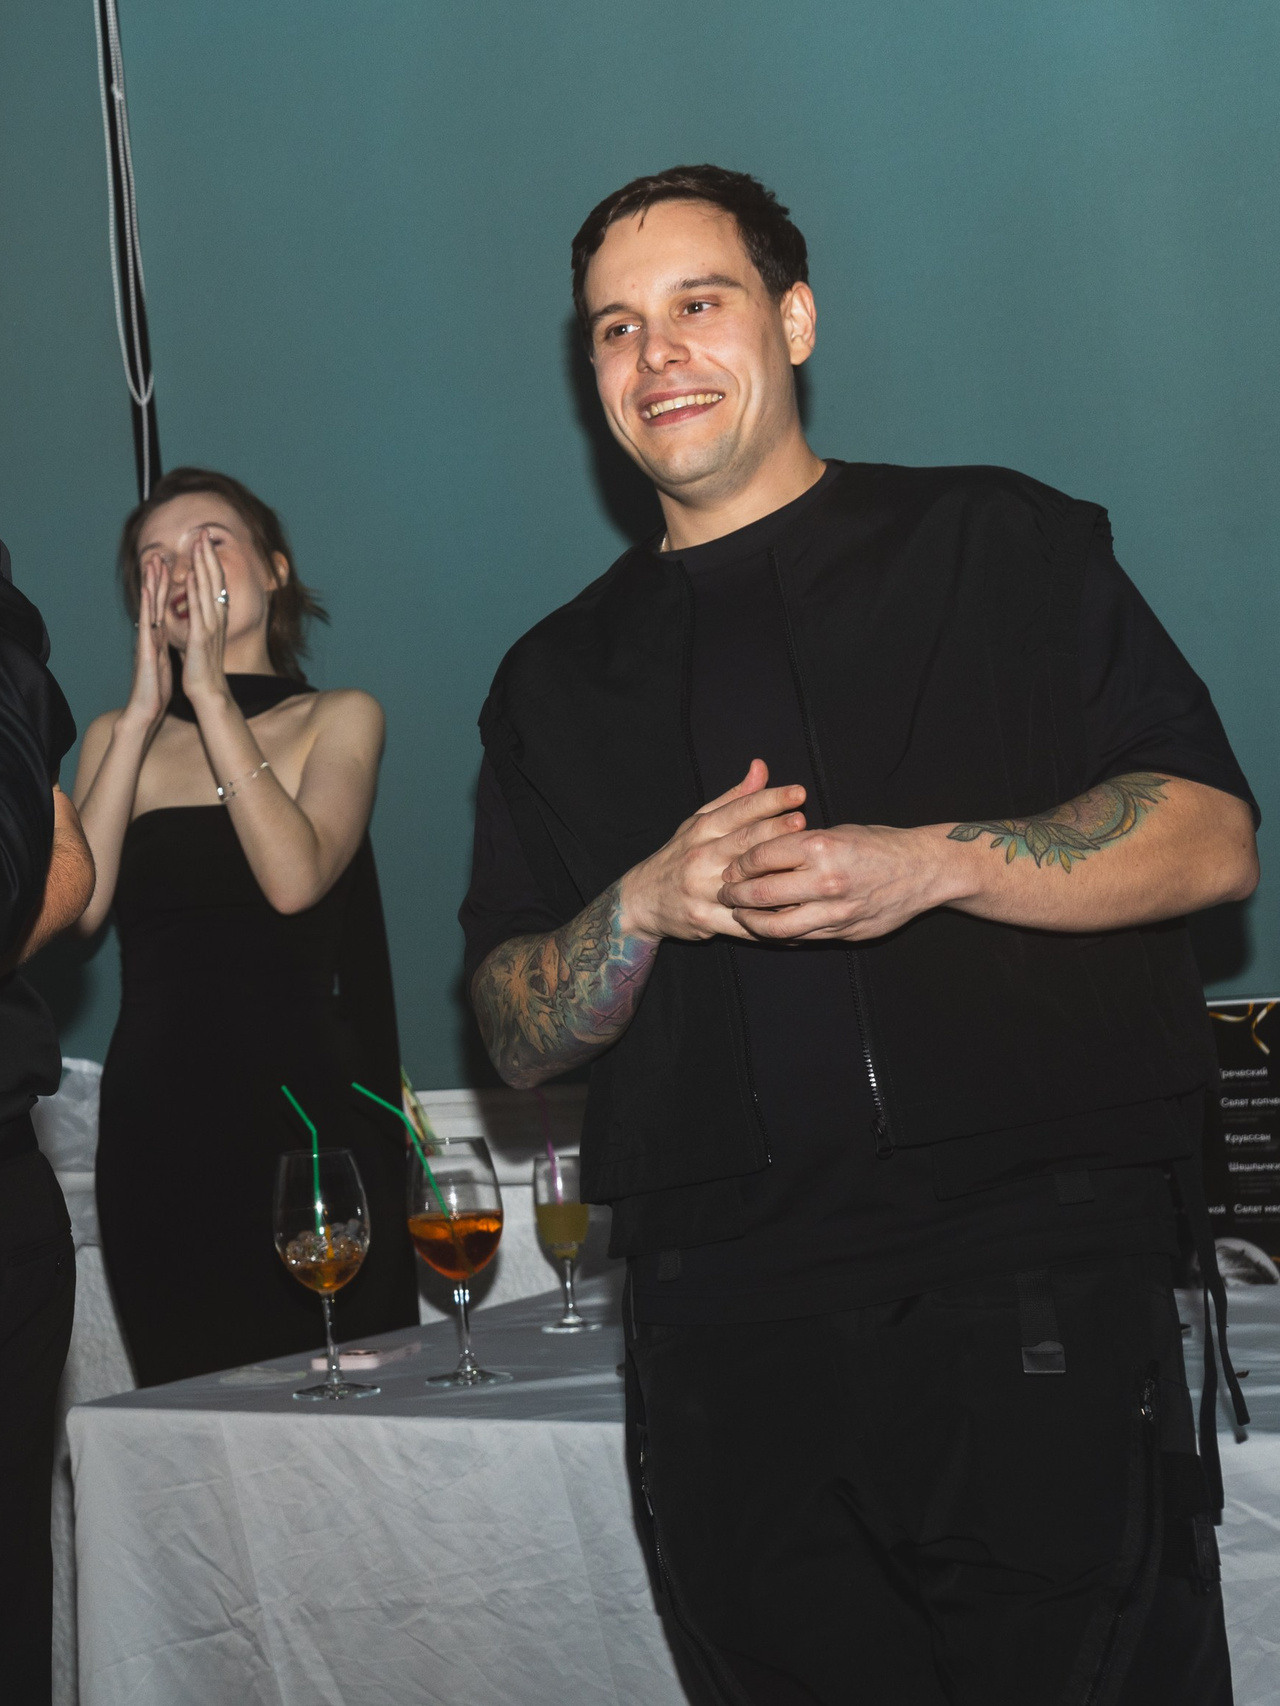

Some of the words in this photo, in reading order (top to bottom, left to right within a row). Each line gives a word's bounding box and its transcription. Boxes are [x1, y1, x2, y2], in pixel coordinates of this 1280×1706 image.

[1220, 1097, 1249, 1108] Салат
[1224, 1133, 1271, 1145] Круассан
[1233, 1203, 1262, 1214] Салат
